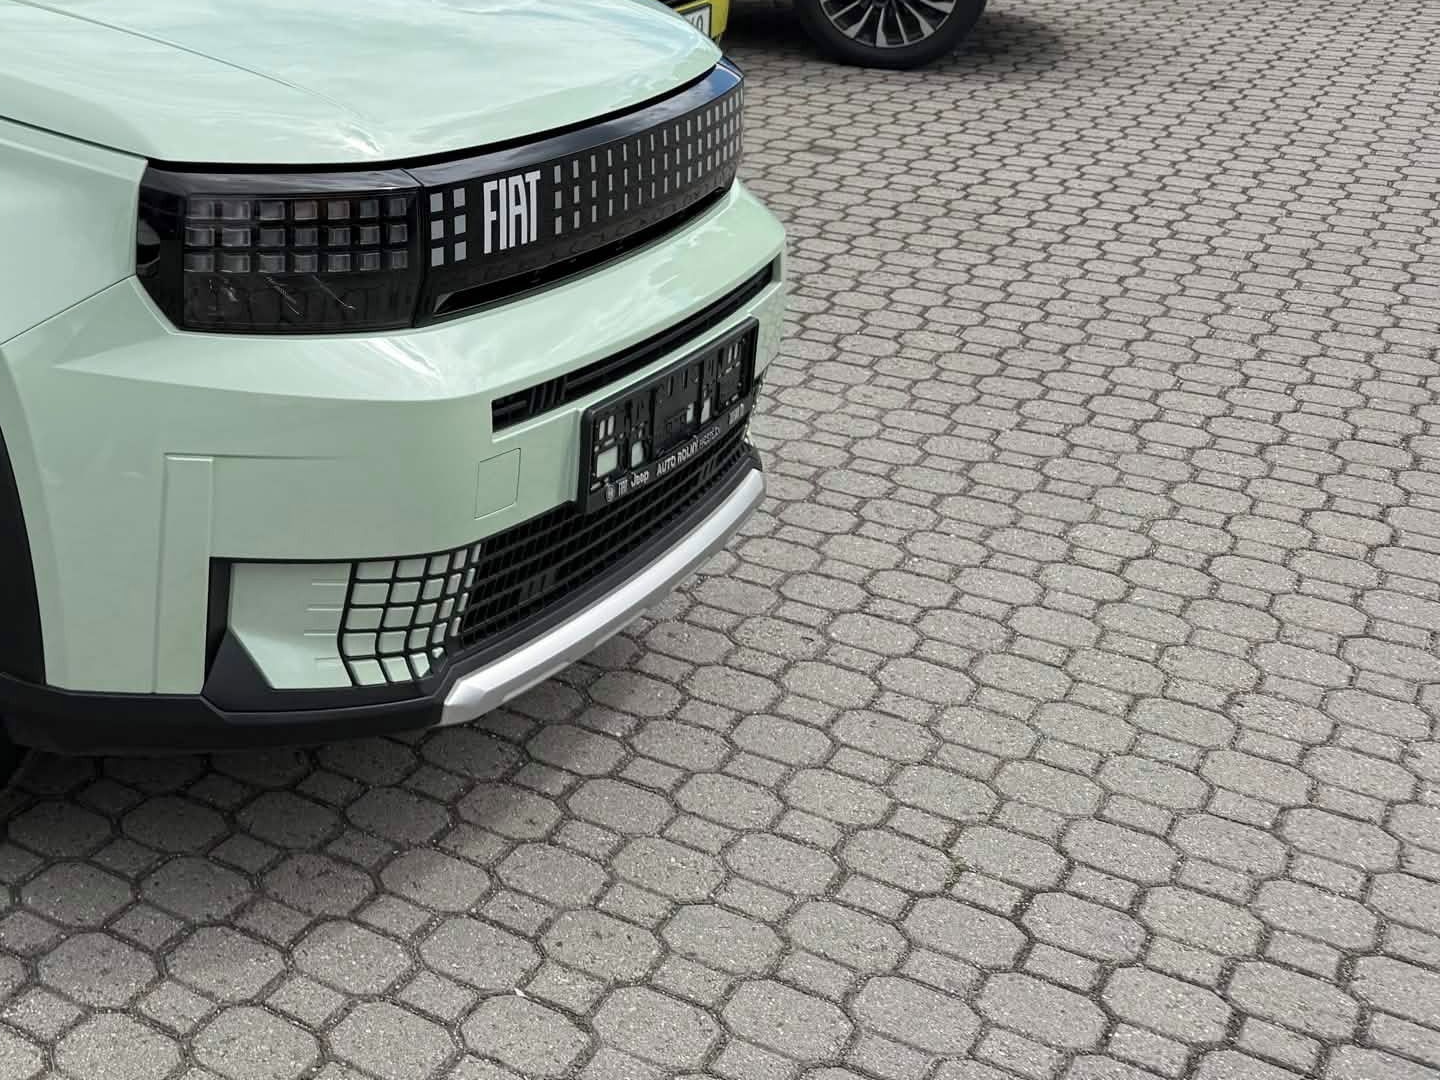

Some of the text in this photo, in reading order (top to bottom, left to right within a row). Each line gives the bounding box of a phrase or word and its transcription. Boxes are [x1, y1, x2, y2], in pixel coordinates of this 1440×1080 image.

[482, 170, 543, 254] FIAT
[630, 470, 650, 489] Jeep
[656, 455, 676, 477] AUTO
